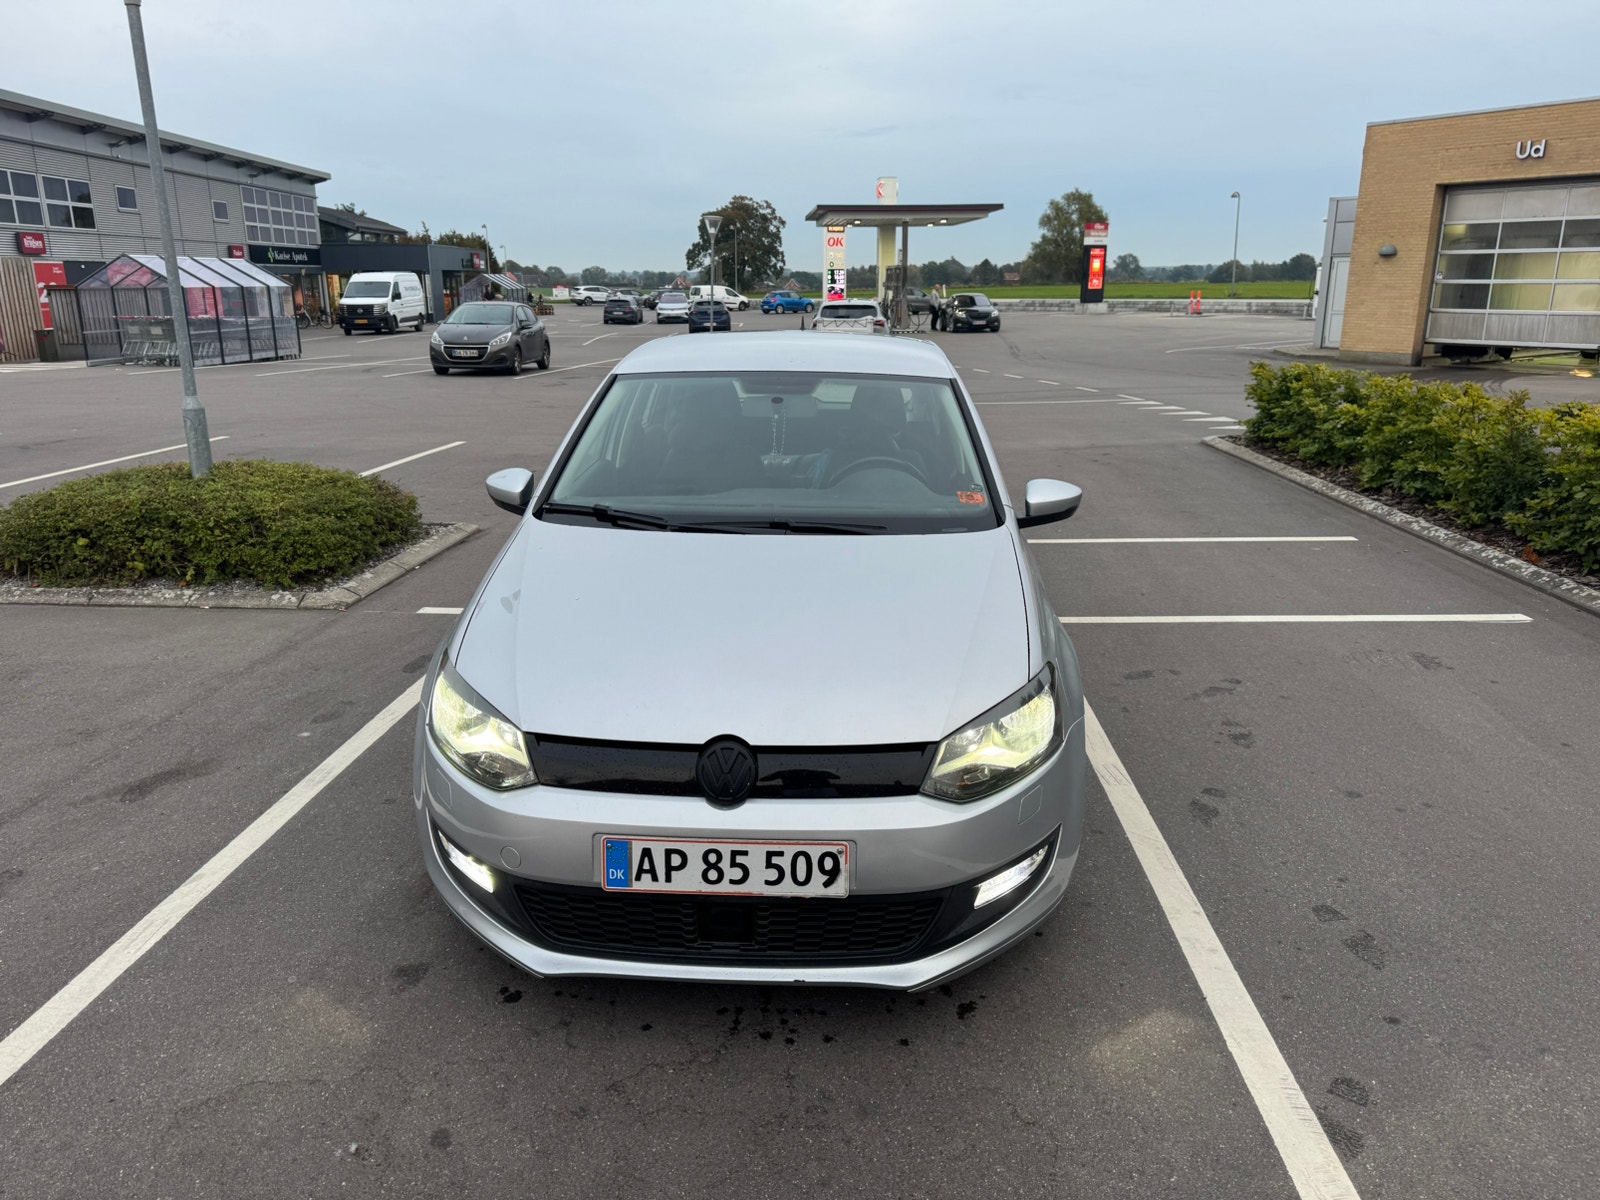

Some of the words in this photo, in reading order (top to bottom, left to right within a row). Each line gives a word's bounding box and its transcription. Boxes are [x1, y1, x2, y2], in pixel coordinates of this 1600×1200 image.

[1516, 139, 1546, 159] Ud
[827, 236, 845, 247] OK
[608, 869, 625, 880] DK
[634, 847, 688, 883] AP
[701, 848, 750, 885] 85
[764, 850, 841, 889] 509
